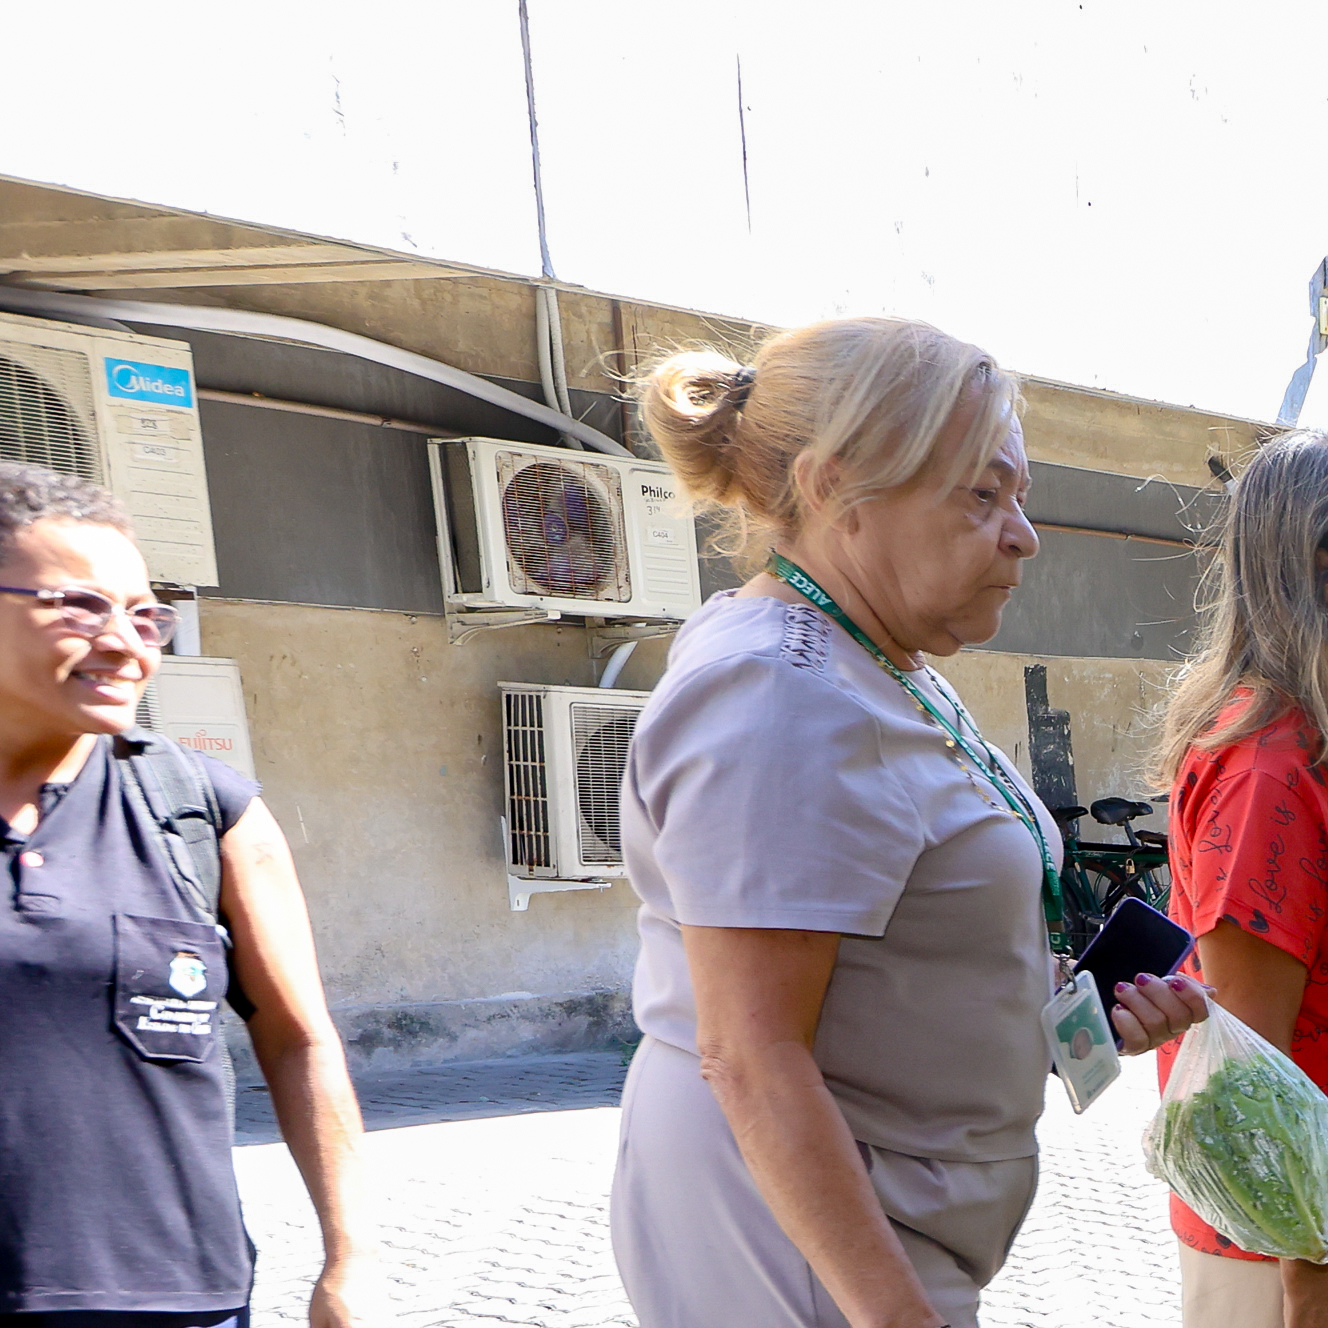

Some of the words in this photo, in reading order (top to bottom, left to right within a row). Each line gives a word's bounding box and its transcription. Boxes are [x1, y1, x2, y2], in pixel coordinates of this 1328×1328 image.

[113, 366, 185, 397] Midea
[641, 485, 675, 499] Philco
[788, 571, 833, 606] ALECE
[178, 730, 233, 751] FUJITSU
[1249, 834, 1287, 914] Love
[1270, 799, 1297, 827] is
